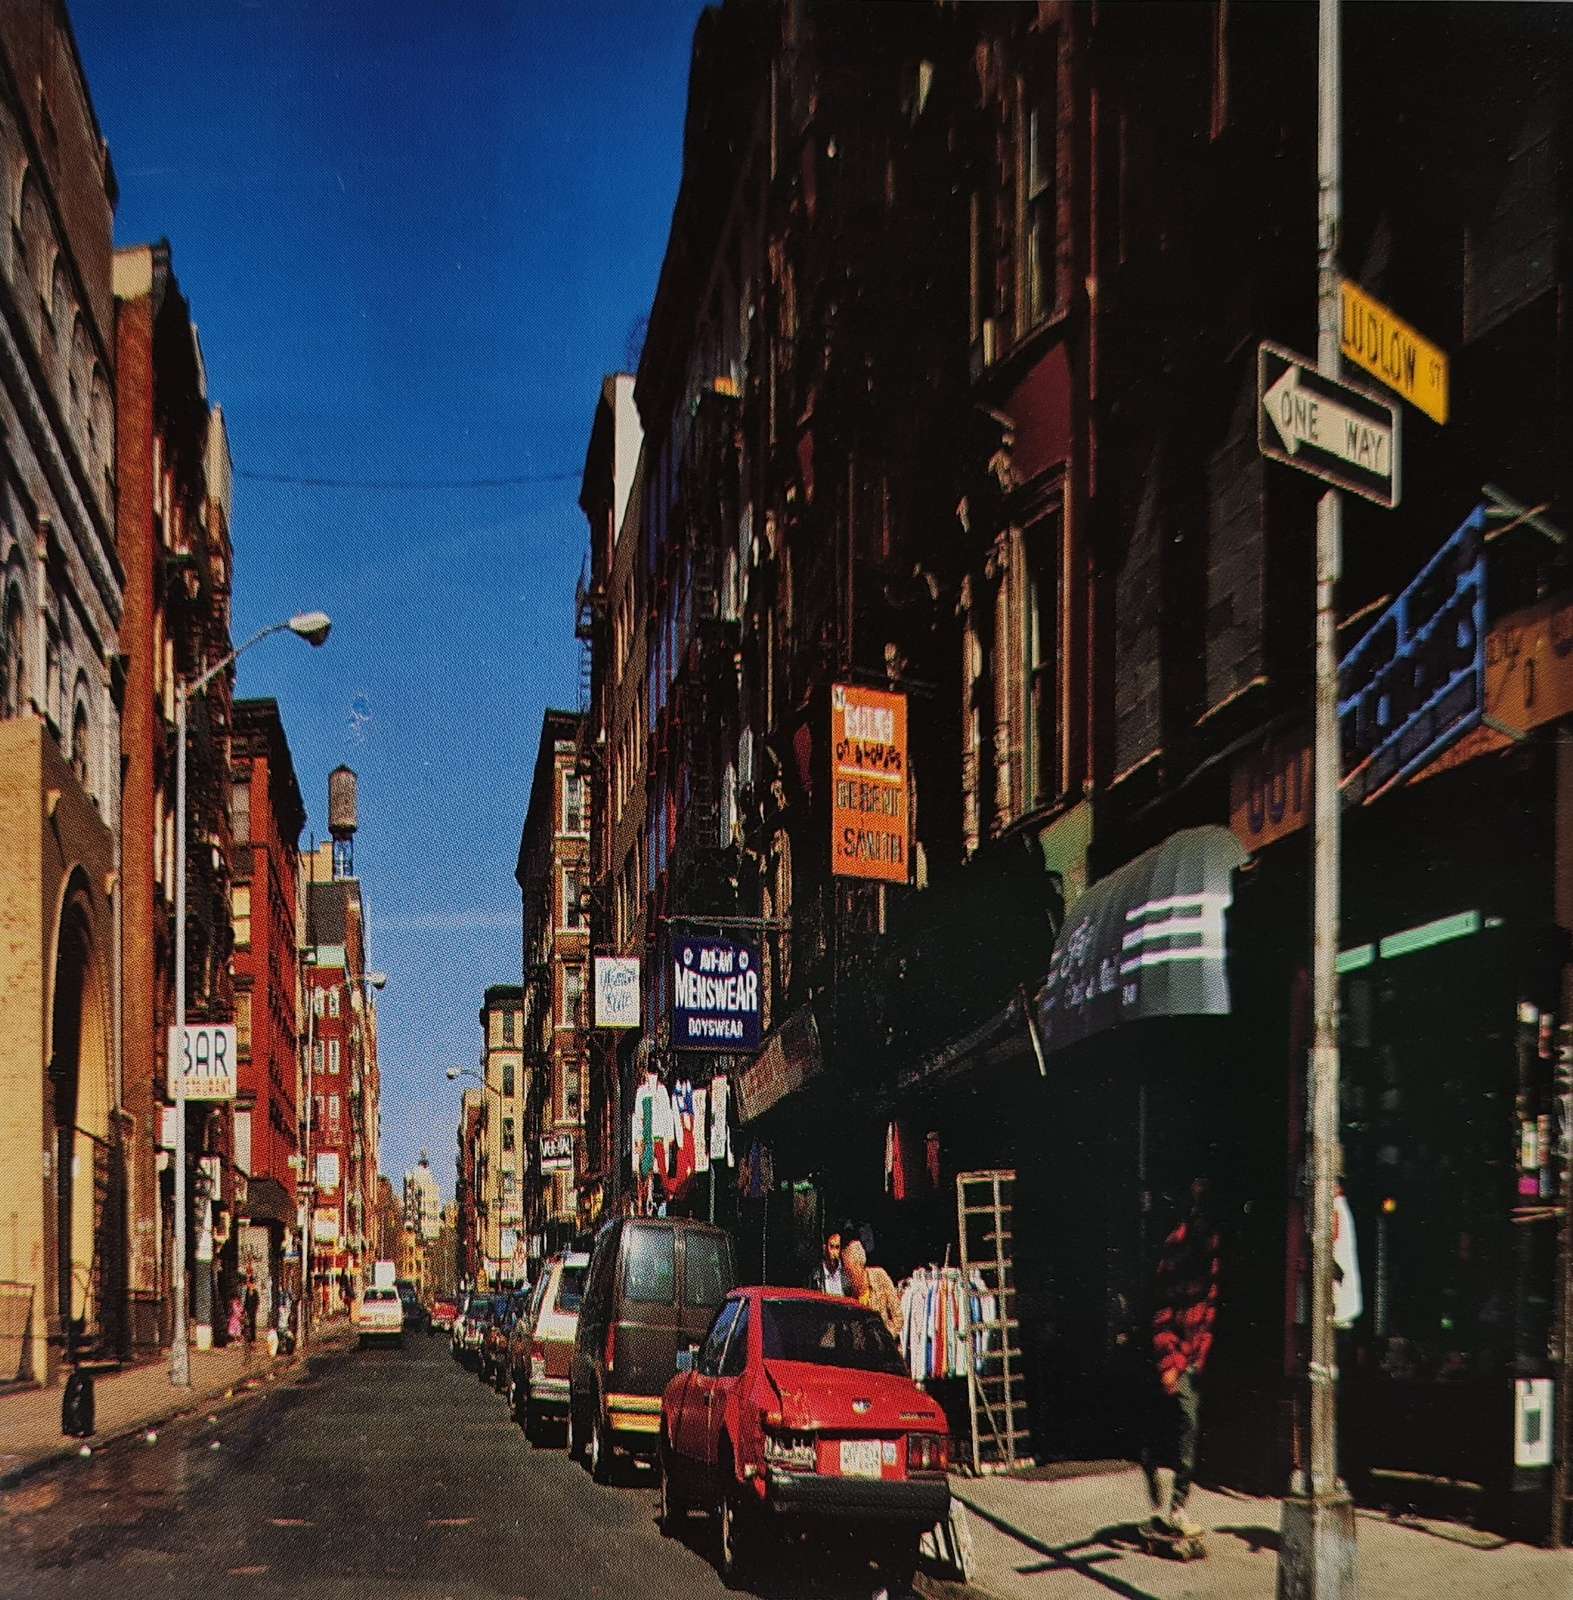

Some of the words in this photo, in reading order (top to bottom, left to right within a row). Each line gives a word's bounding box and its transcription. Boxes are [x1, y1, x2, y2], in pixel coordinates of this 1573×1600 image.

[1341, 291, 1416, 396] LUDLOW
[1428, 357, 1443, 393] ST
[1280, 389, 1318, 442] ONE
[1344, 417, 1383, 471] WAY
[674, 957, 758, 1012] MENSWEAR
[687, 1016, 744, 1039] BOYSWEAR
